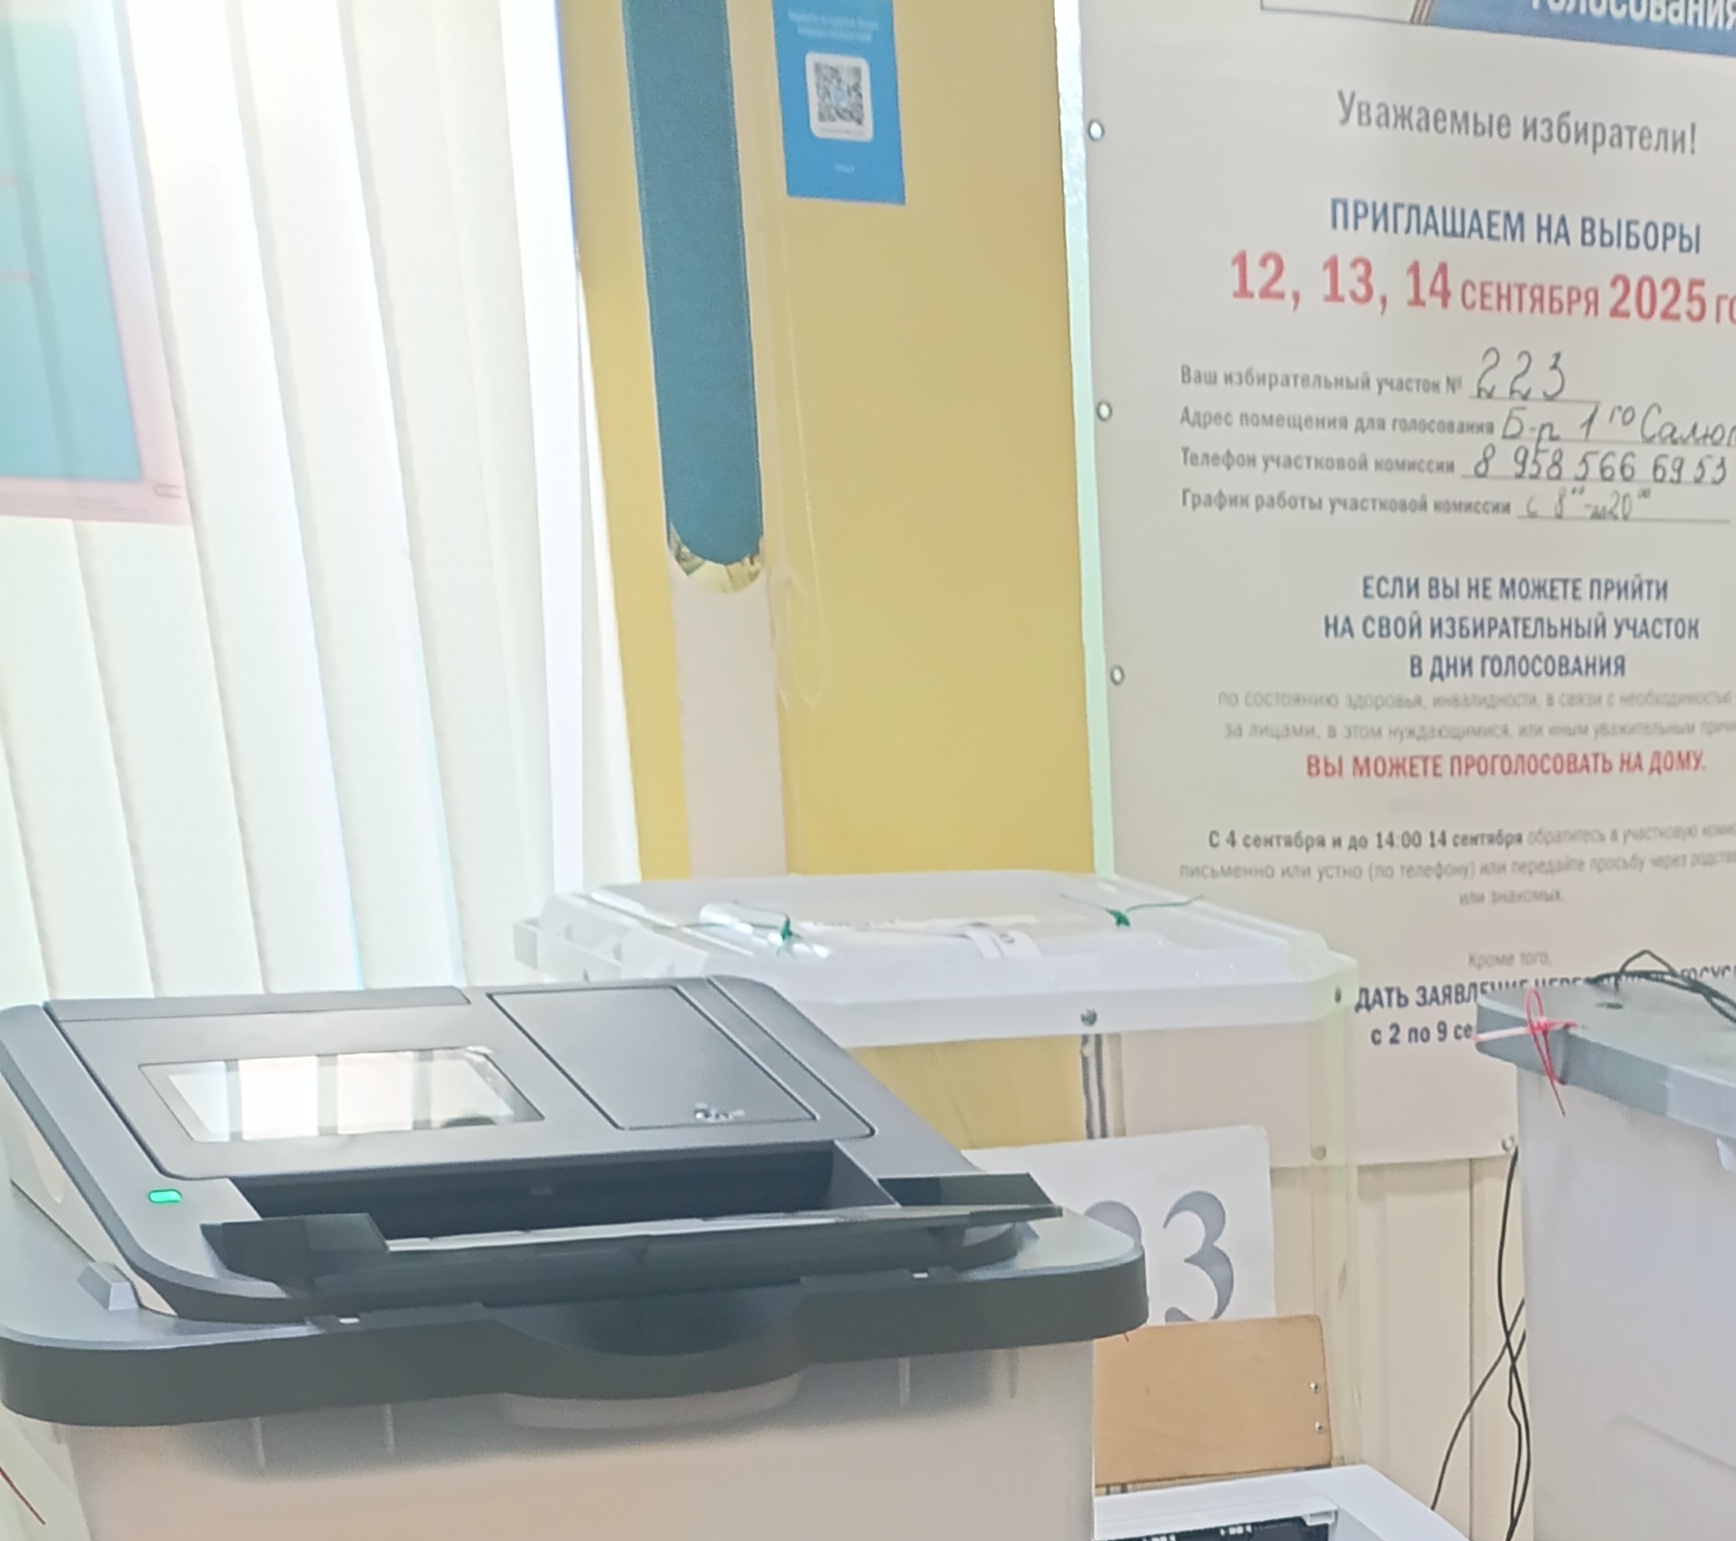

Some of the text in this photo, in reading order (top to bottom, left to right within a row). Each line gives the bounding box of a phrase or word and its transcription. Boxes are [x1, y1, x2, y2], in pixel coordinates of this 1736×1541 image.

[1337, 90, 1697, 155] Уважаемые избиратели!
[1331, 198, 1701, 254] ПРИГЛАШАЕМ НА ВЫБОРЫ
[1230, 250, 1301, 312] 12,
[1321, 254, 1389, 316] 13,
[1405, 260, 1452, 310] 14
[1460, 278, 1600, 318] СЕНТЯБРЯ
[1608, 272, 1707, 323] 2025
[1181, 365, 1217, 385] Ваш
[1224, 367, 1370, 391] избирательный
[1376, 376, 1440, 395] участок
[1476, 346, 1566, 401] 223
[1181, 406, 1495, 435] Адрес помещения для голосования
[1182, 446, 1455, 474] Телефон участковой комиссии
[1473, 443, 1496, 478] 8
[1182, 488, 1512, 516] График работы участковой комиссии
[1362, 573, 1668, 600] ЕСЛИ ВЫ НЕ МОЖЕТЕ ПРИЙТИ
[1324, 610, 1700, 640] НА СВОЙ ИЗБИРАТЕЛЬНЫЙ УЧАСТОК
[1411, 654, 1626, 682] В ДНИ ГОЛОСОВАНИЯ
[1307, 749, 1706, 777] ВЫ МОЖЕТЕ ПРОГОЛОСОВАТЬ НА ДОМУ.
[1209, 829, 1220, 848] С
[1226, 829, 1236, 848] 4
[1242, 830, 1326, 852] сентября
[1332, 834, 1342, 848] и
[1347, 833, 1368, 851] до
[1375, 830, 1423, 849] 14:00
[1429, 829, 1447, 848] 14
[1453, 829, 1523, 849] сентября
[1468, 951, 1516, 970] Кроме
[1354, 986, 1410, 1013] ДАТЬ
[1371, 1028, 1382, 1045] с
[1389, 1022, 1401, 1045] 2
[1407, 1025, 1432, 1044] по
[1437, 1020, 1448, 1042] 9
